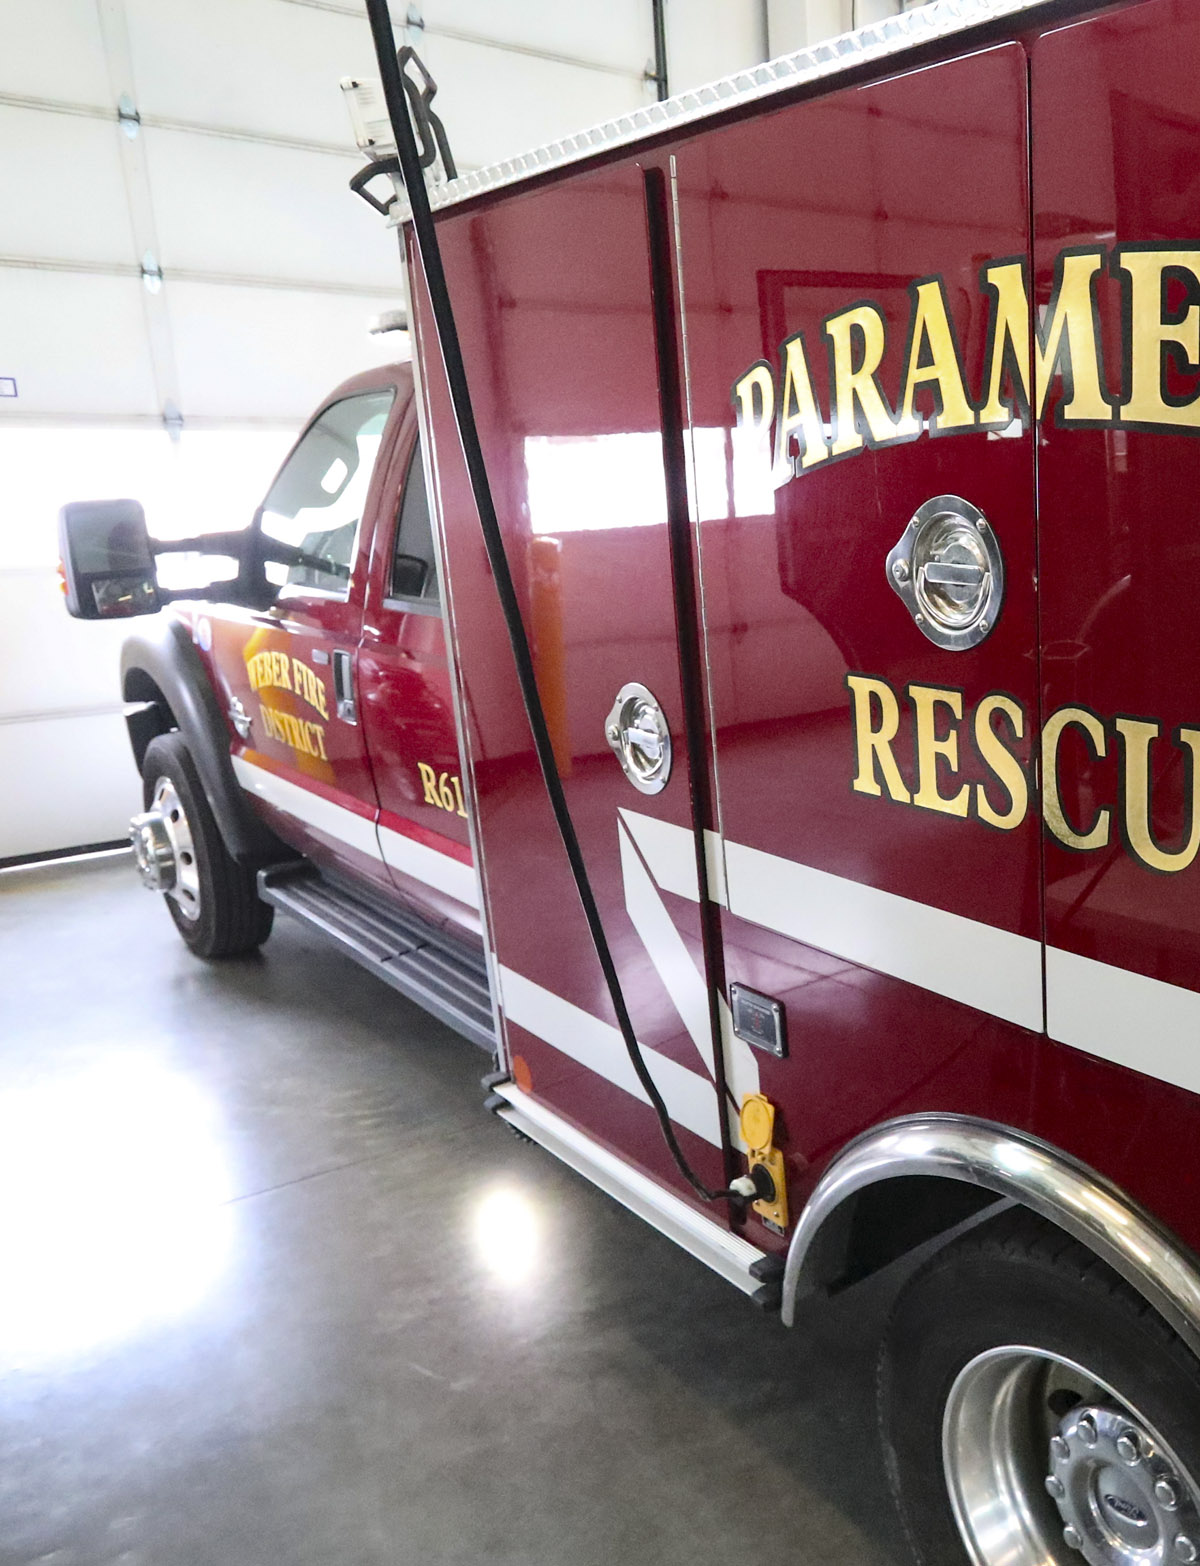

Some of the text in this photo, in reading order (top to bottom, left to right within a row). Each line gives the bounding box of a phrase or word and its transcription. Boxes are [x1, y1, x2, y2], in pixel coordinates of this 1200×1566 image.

[247, 651, 329, 720] WEBER FIRE
[259, 703, 328, 761] DISTRICT
[417, 762, 469, 818] R61
